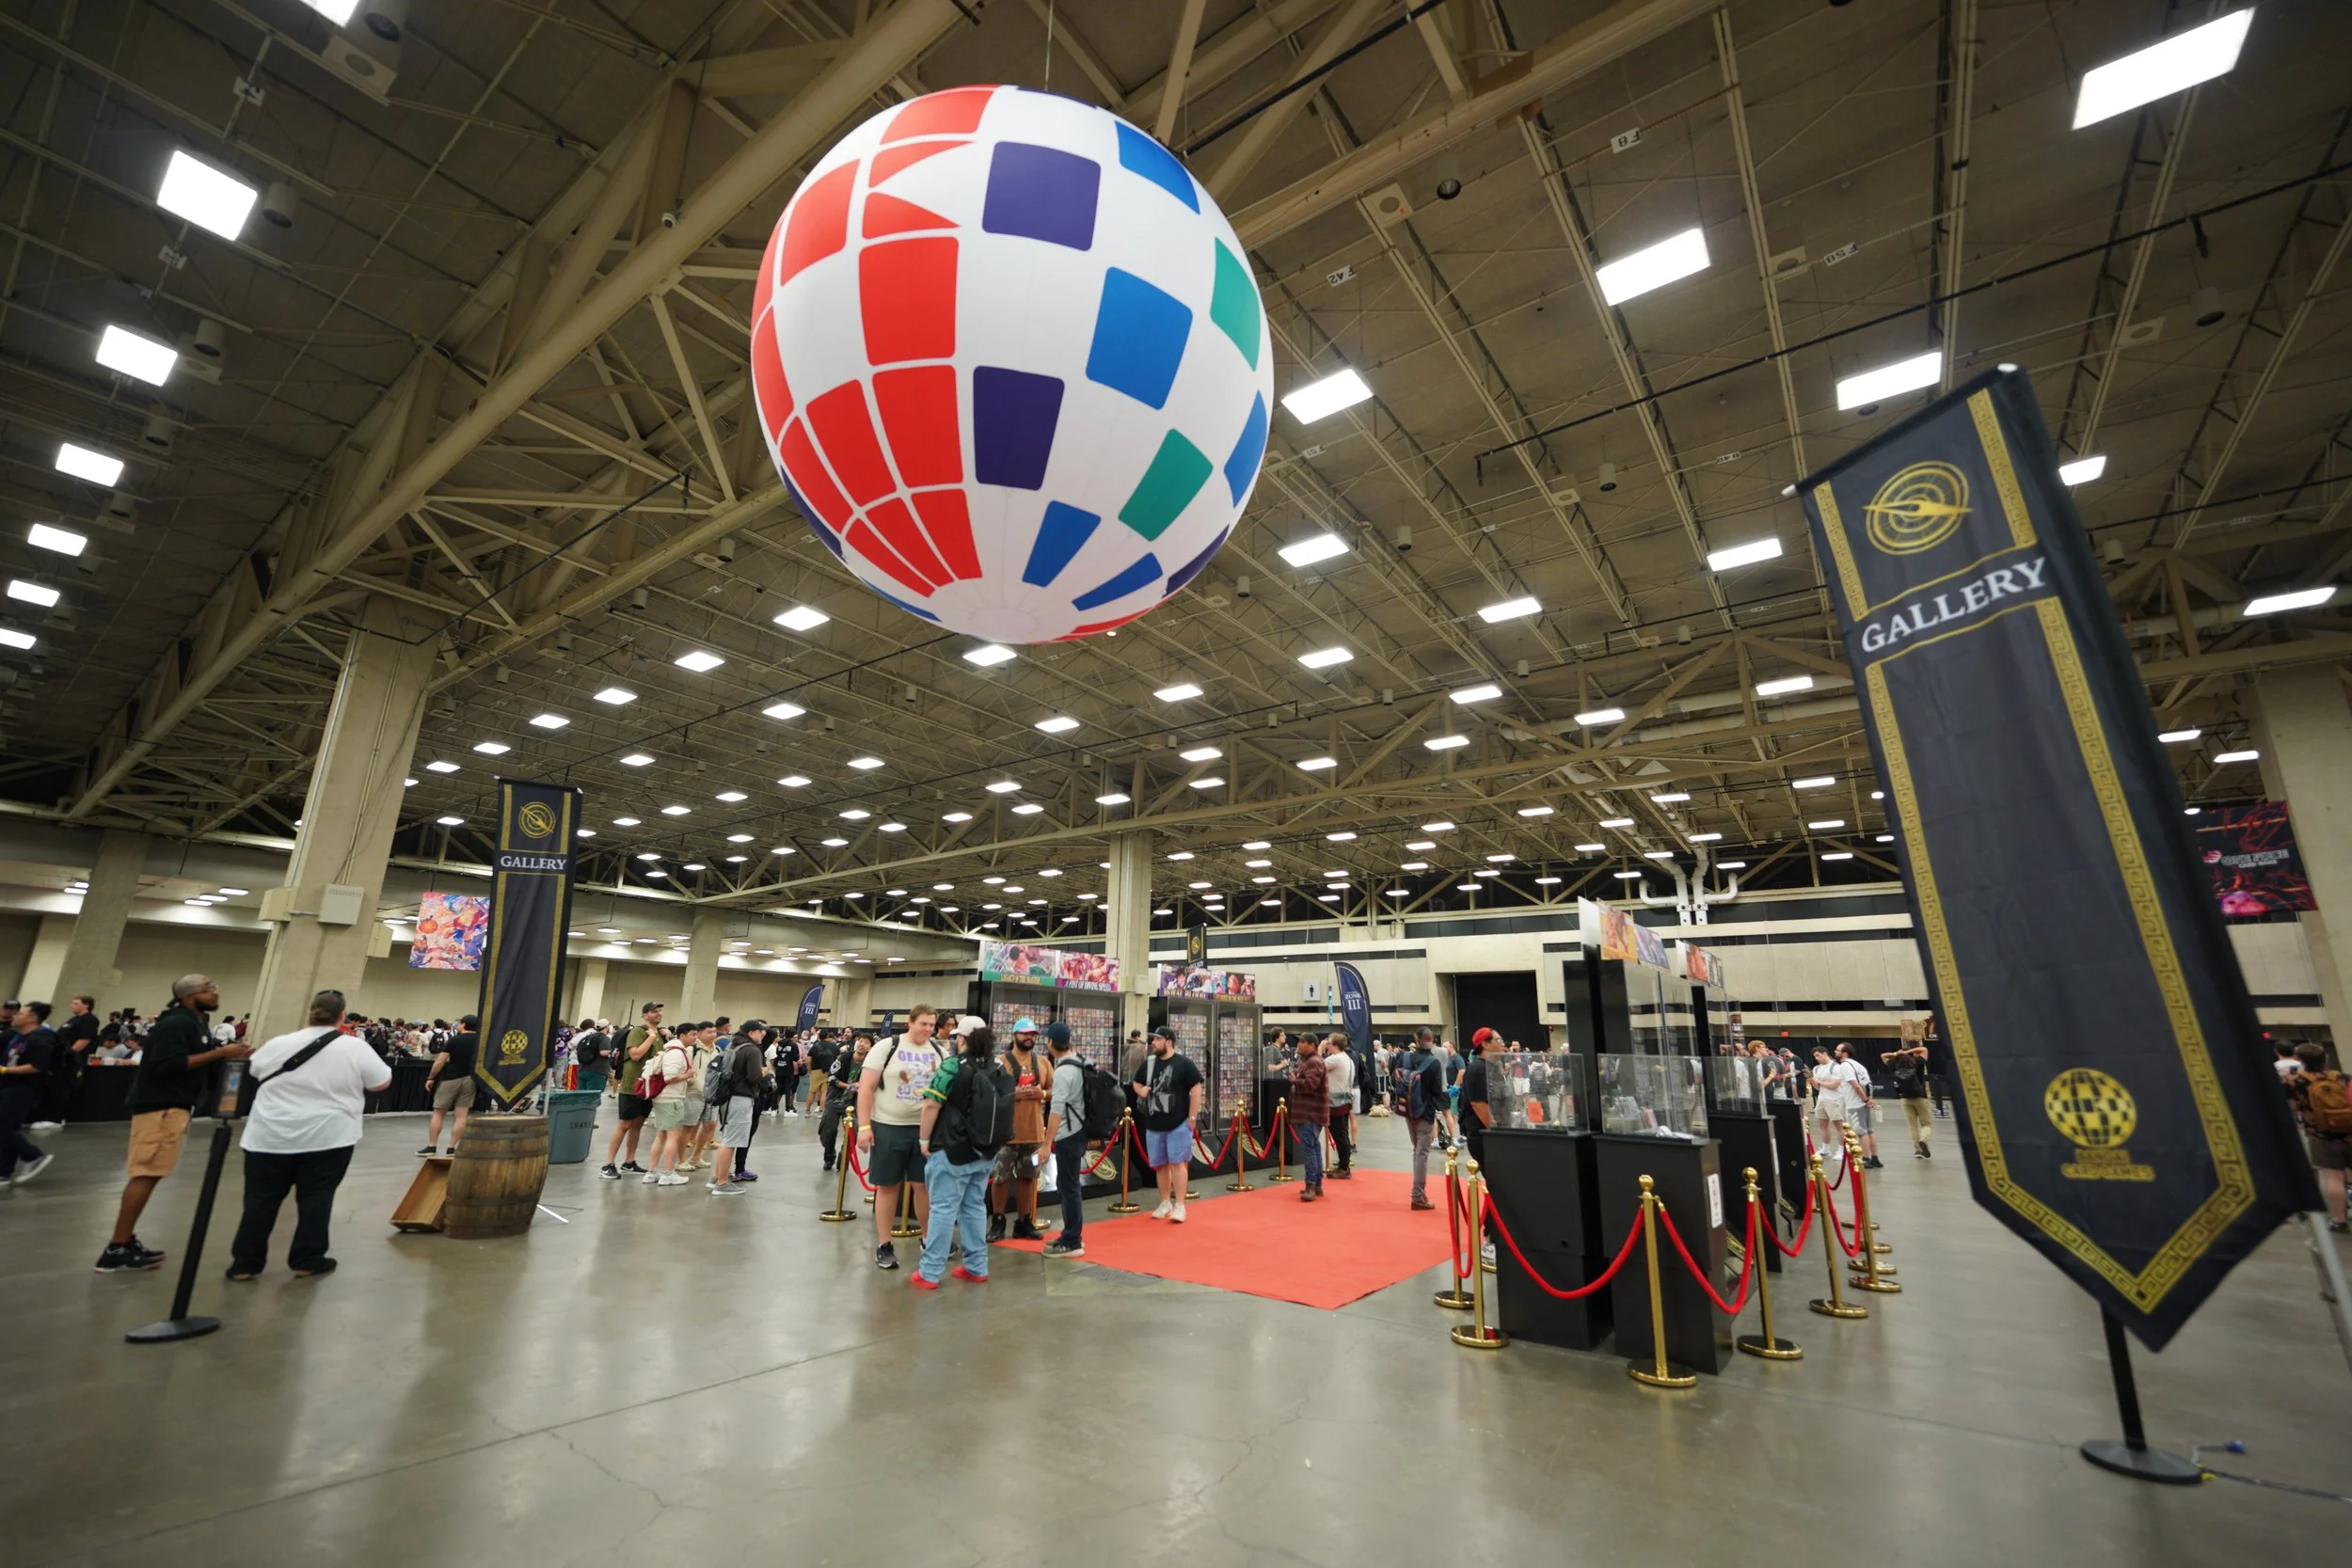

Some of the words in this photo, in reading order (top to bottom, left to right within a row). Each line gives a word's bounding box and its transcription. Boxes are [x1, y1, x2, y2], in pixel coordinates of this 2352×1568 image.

[1862, 557, 2046, 652] GALLERY
[500, 855, 567, 870] GALLERY
[1347, 999, 1361, 1010] III
